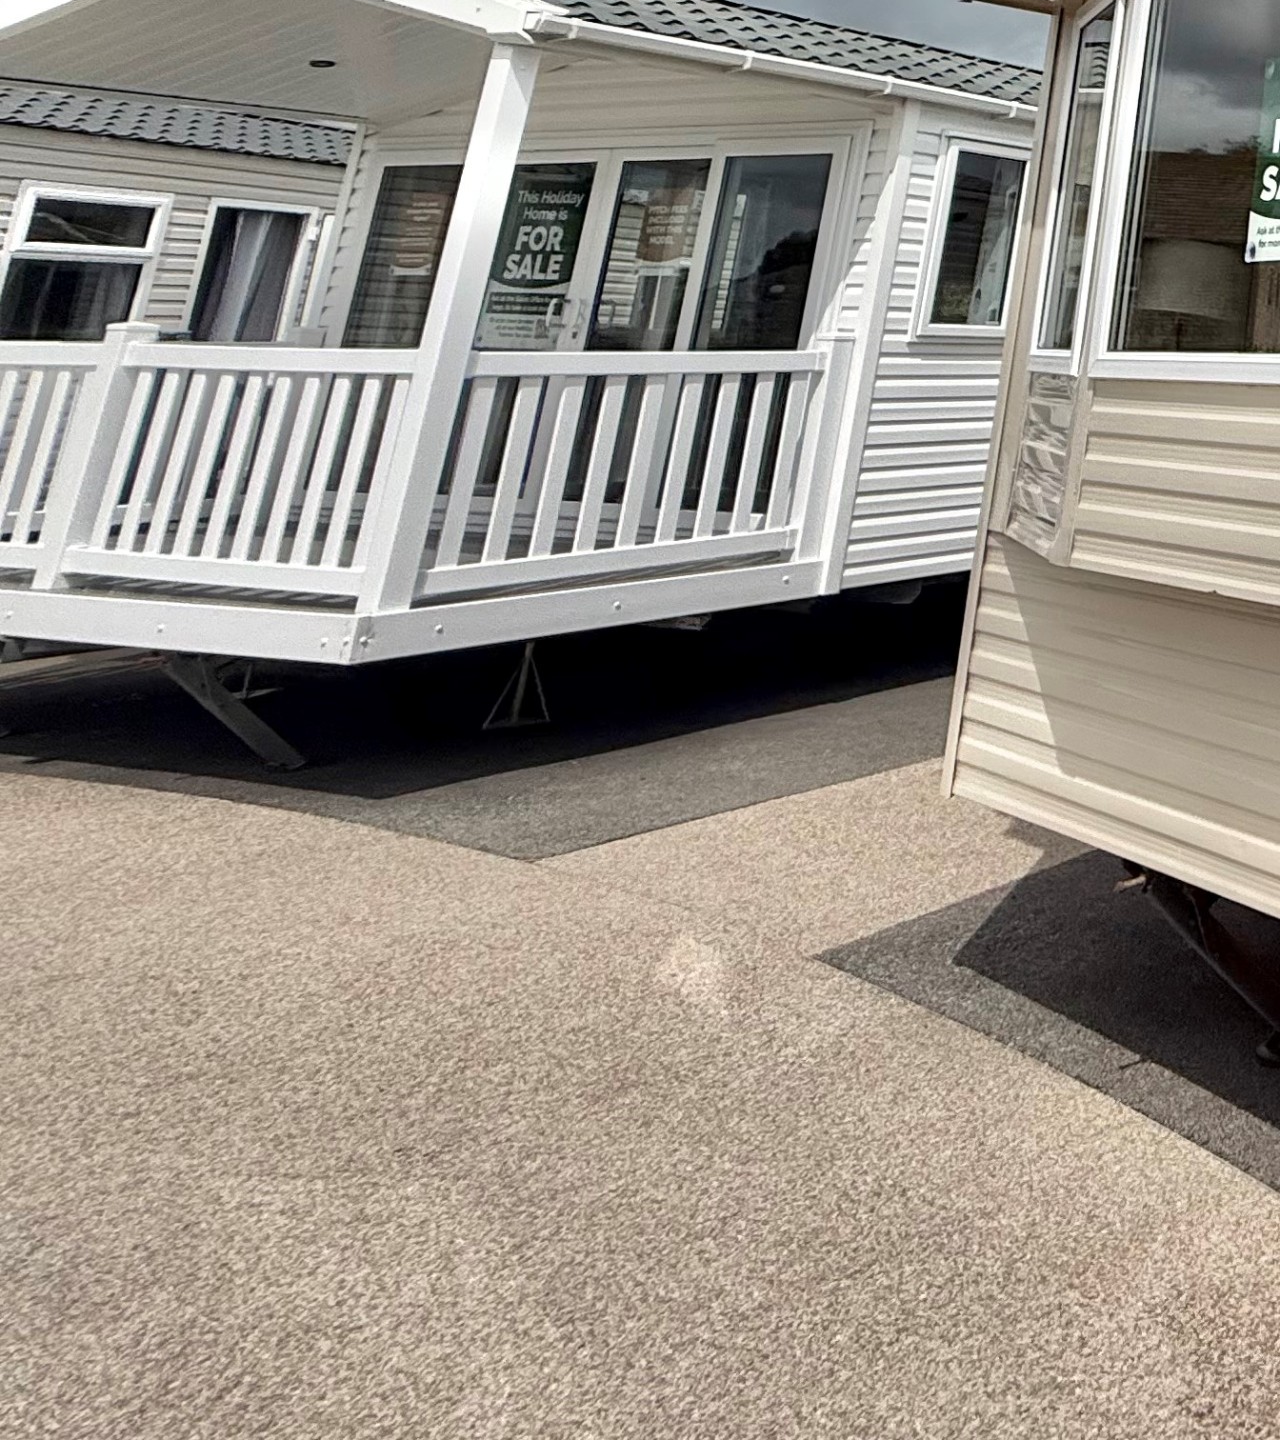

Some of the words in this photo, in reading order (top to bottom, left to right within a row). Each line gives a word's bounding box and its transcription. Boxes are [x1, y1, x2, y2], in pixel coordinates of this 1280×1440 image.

[518, 190, 539, 203] This
[541, 190, 585, 207] Holiday
[523, 207, 557, 220] Home
[558, 207, 568, 220] is
[515, 225, 564, 251] FOR
[503, 253, 564, 279] SALE
